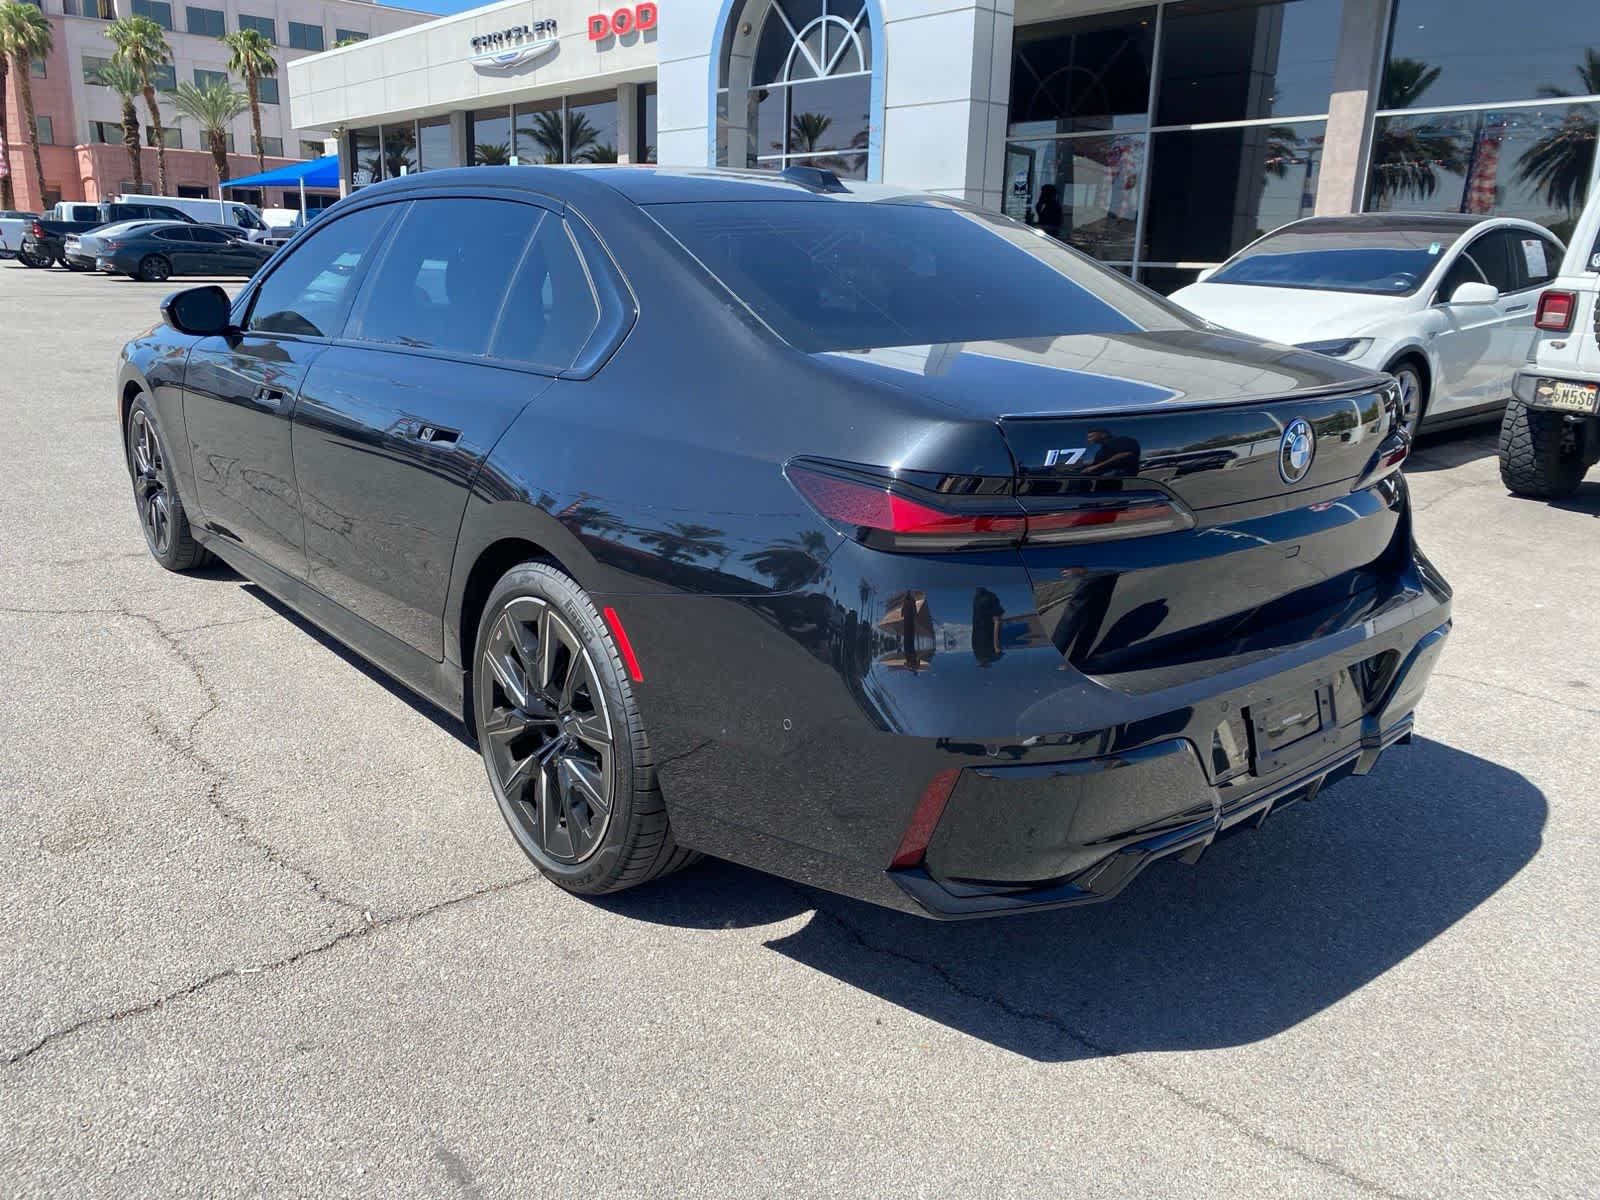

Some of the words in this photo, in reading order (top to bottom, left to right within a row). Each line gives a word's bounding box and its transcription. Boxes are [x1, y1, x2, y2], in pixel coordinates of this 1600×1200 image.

[472, 19, 557, 47] CHRYSLER
[588, 3, 657, 40] DOD
[1044, 448, 1087, 466] i7
